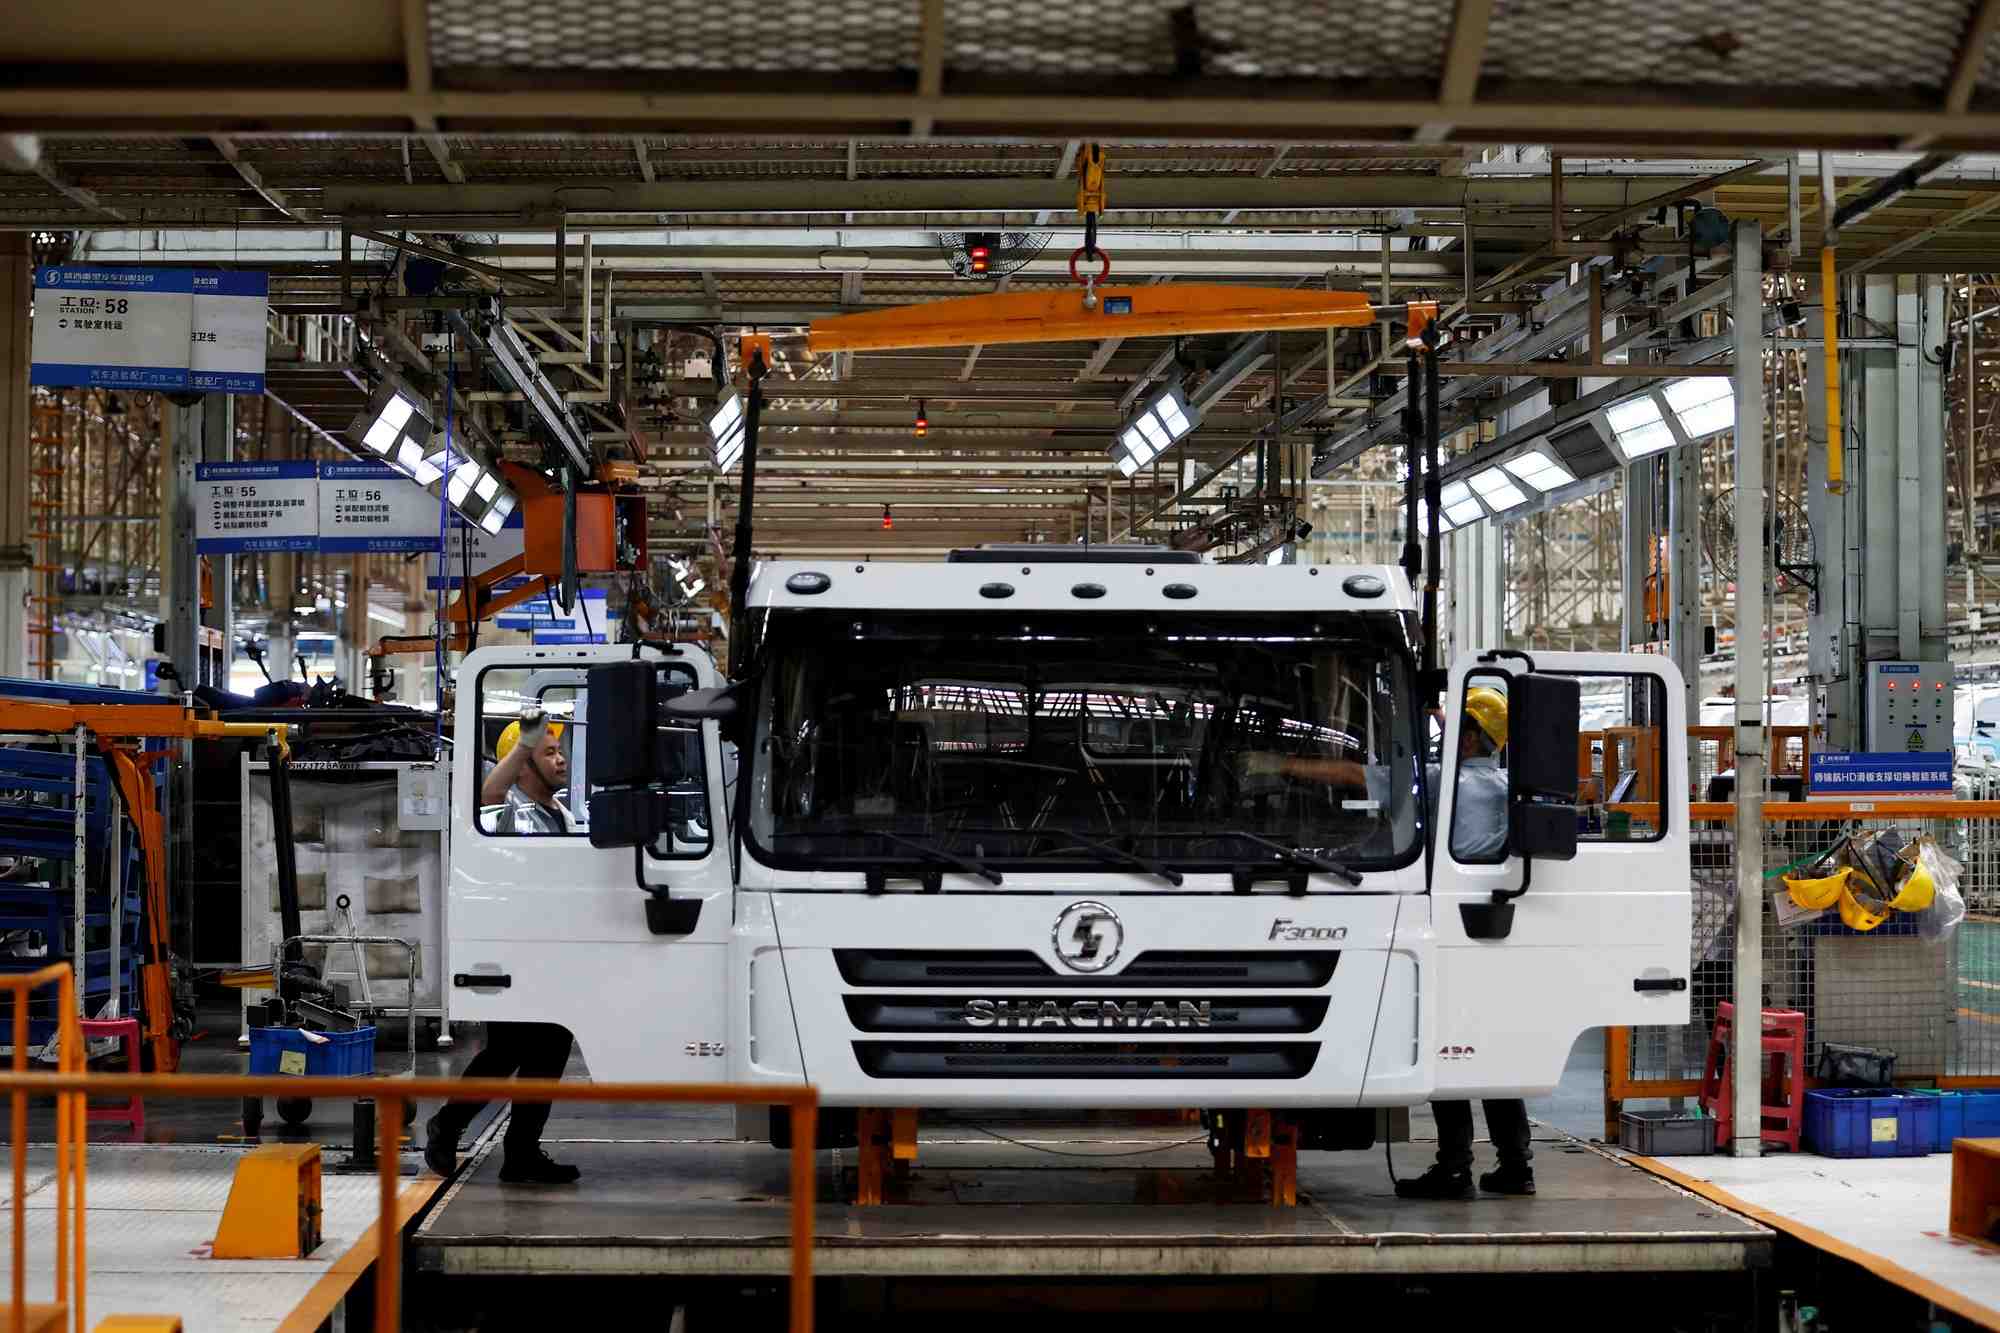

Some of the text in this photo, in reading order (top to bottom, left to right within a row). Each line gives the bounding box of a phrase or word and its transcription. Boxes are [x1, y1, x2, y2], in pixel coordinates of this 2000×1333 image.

[105, 298, 128, 314] 58
[240, 486, 257, 497] 55
[365, 490, 381, 501] 56
[1268, 918, 1348, 941] F3000
[964, 999, 1212, 1028] SHACMAN
